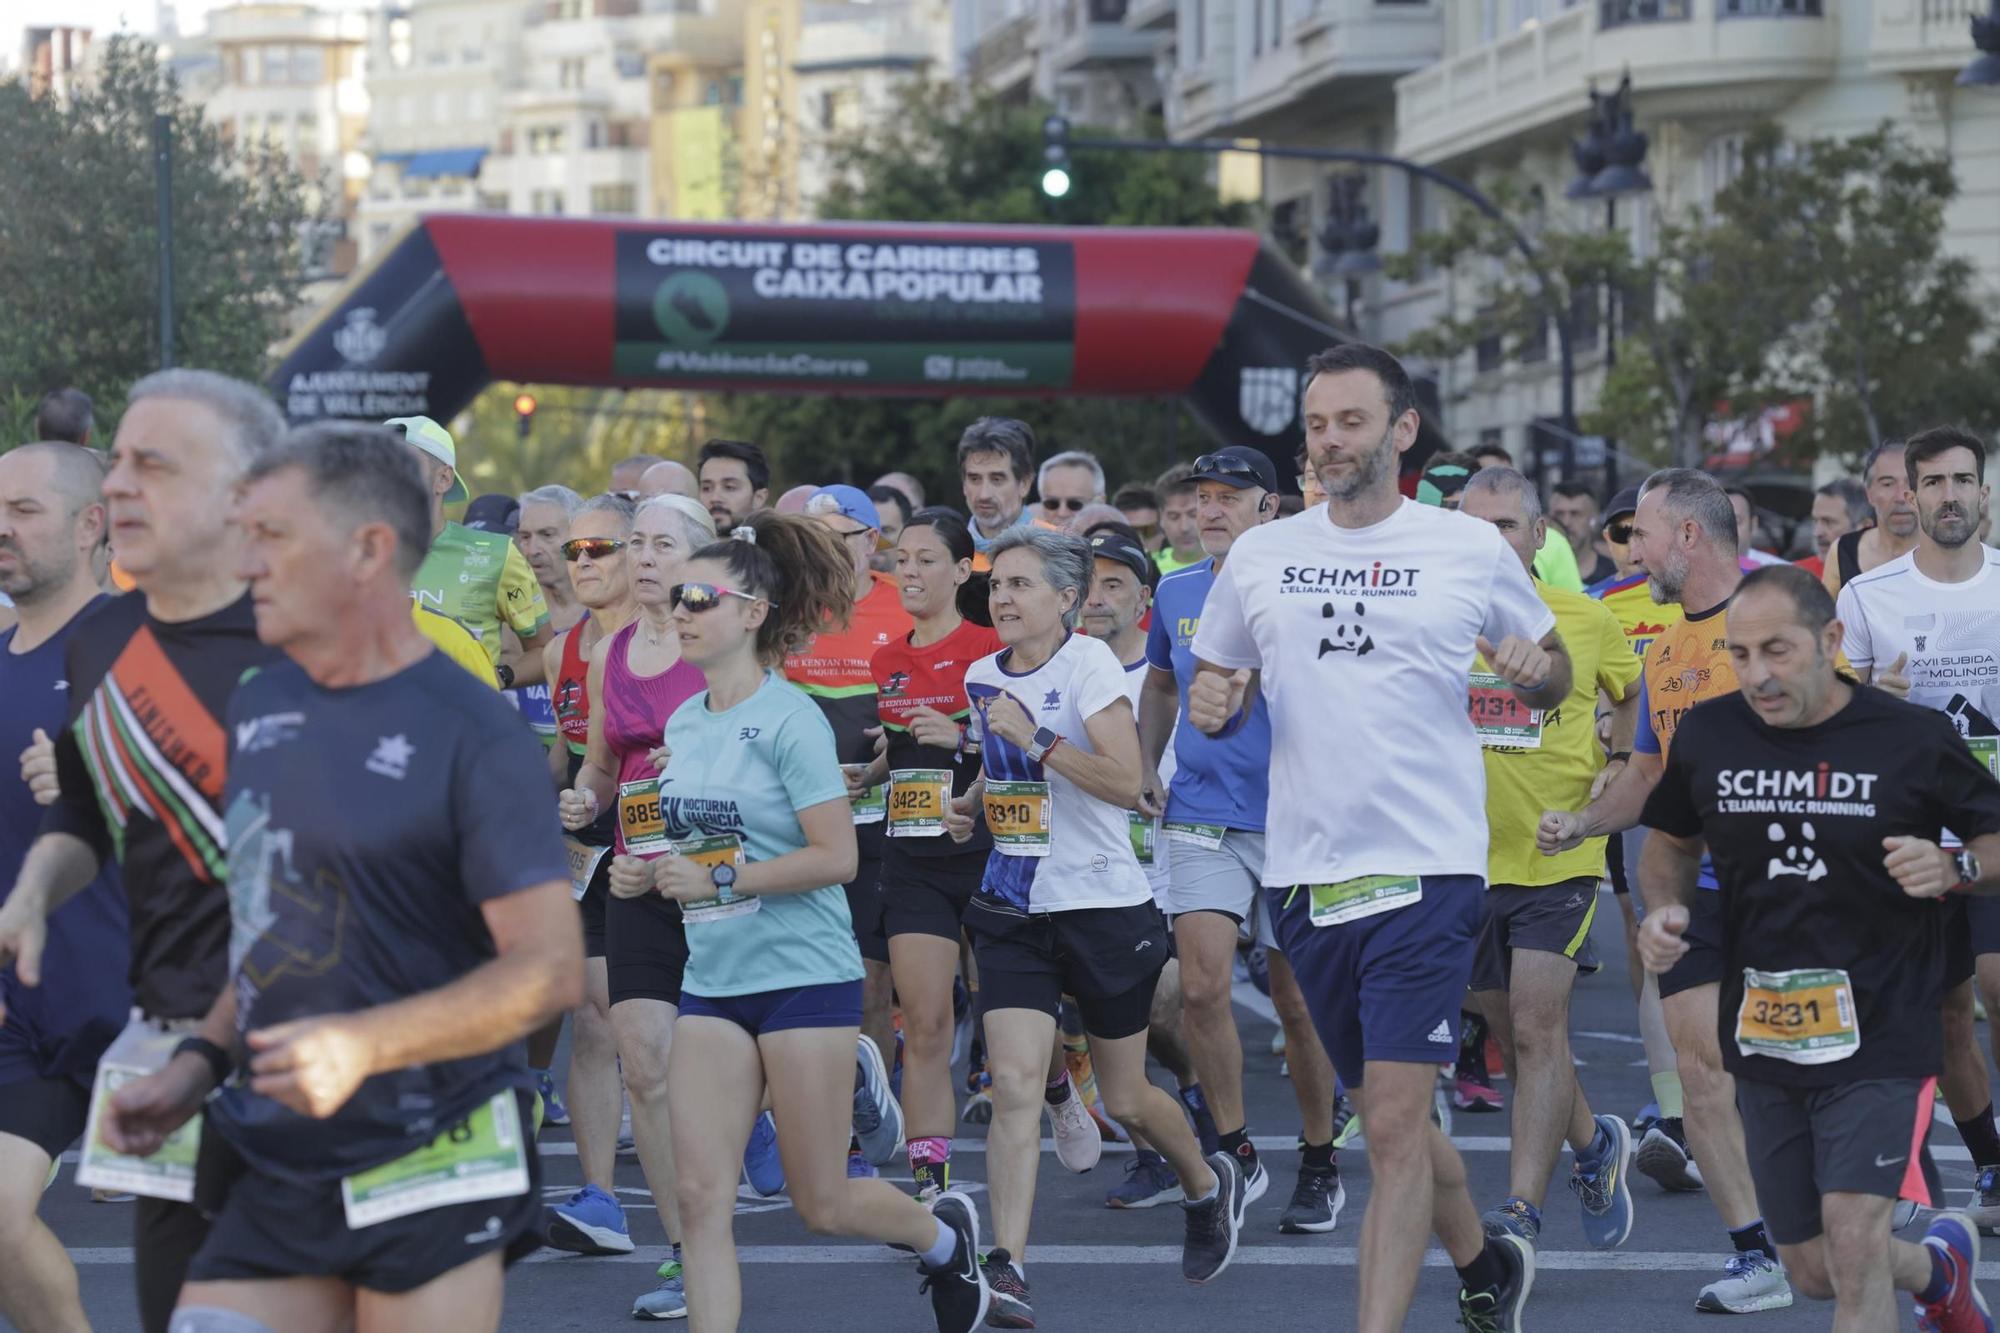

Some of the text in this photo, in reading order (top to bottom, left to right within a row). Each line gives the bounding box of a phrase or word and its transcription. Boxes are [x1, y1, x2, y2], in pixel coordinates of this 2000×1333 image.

[647, 239, 1039, 274] CIRCUIT DE CARRERES
[1335, 588, 1358, 596] VLC
[1361, 589, 1417, 597] RUNNING
[1912, 655, 1994, 667] XVII SUBIDA
[1930, 666, 1999, 678] MOLINOS
[683, 797, 738, 813] NOCTURNA
[893, 790, 931, 809] 3422
[1718, 799, 1876, 817] L'ELIANA VLC RUNNING
[684, 811, 745, 827] VALENCIA
[988, 803, 1030, 823] 3310
[1753, 999, 1821, 1027] 3231
